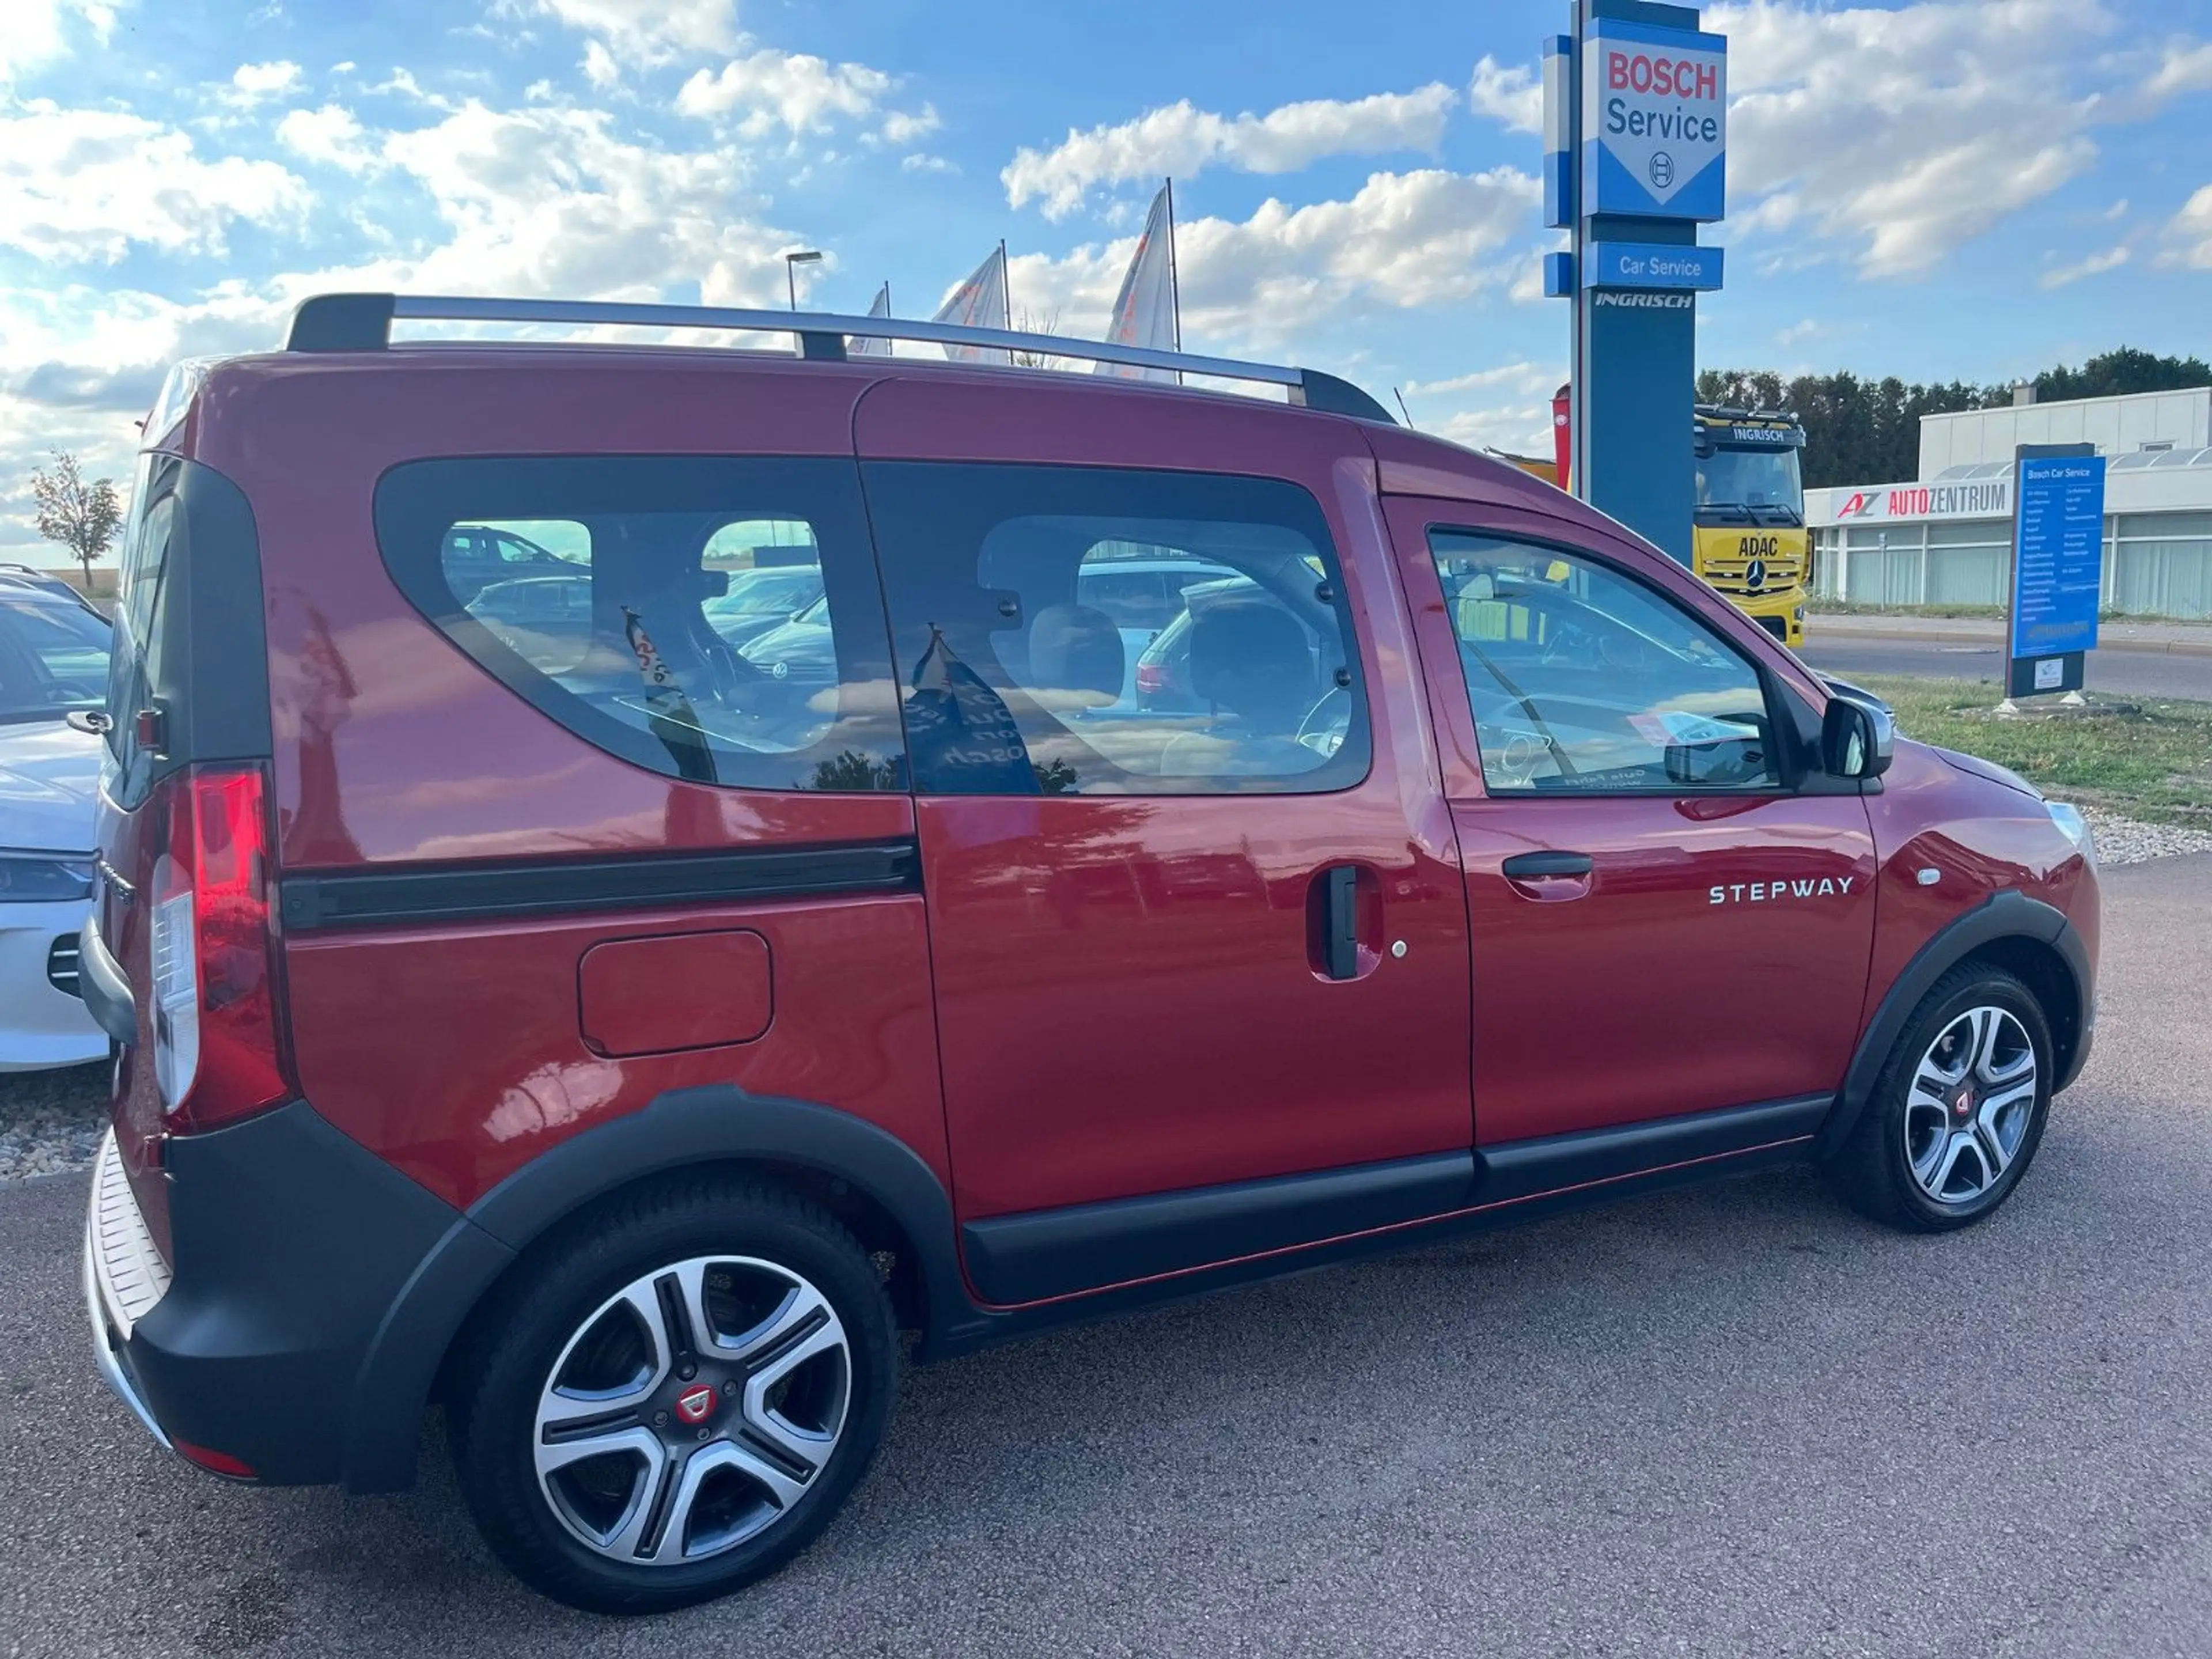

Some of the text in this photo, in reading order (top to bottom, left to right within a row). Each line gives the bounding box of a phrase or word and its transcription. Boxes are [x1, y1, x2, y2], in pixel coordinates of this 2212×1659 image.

[1609, 52, 1716, 100] BOSCH
[1607, 99, 1717, 142] Service
[1620, 256, 1702, 276] Car Service
[1595, 293, 1693, 308] INGRISCH
[1733, 428, 1784, 442] INGRISCH
[2028, 468, 2090, 479] Bosch Car Service
[1837, 484, 2005, 518] AZ AUTOZENTRUM
[1738, 537, 1778, 556] ADAC
[1710, 876, 1854, 904] STEPWAY
